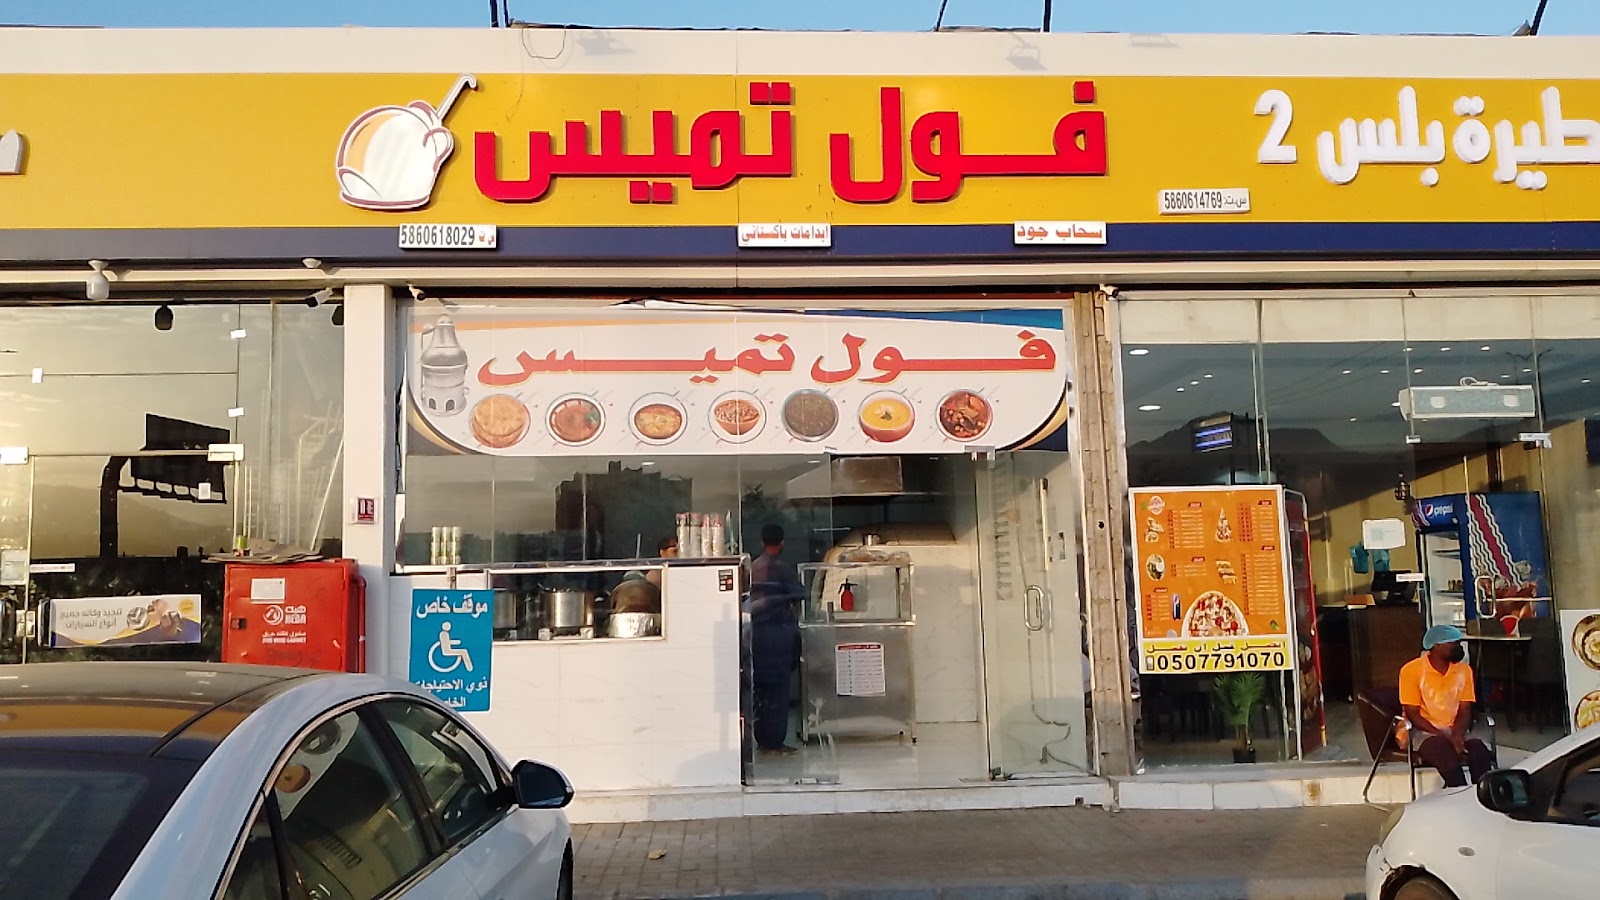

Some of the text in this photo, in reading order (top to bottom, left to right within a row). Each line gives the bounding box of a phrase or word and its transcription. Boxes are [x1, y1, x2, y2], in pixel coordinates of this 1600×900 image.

[474, 80, 1107, 203] فول تميس
[1254, 85, 1600, 190] طيرة بلس 2
[1164, 191, 1222, 209] 5860614769
[401, 225, 475, 246] 5860618029
[742, 224, 788, 245] باكستاني
[1017, 223, 1102, 241] سحاب جود
[477, 329, 1057, 387] فول تميس
[416, 592, 488, 618] موقف خاص
[1157, 651, 1285, 670] 0507791070
[465, 676, 488, 694] ذوي
[443, 696, 467, 708] الخا
